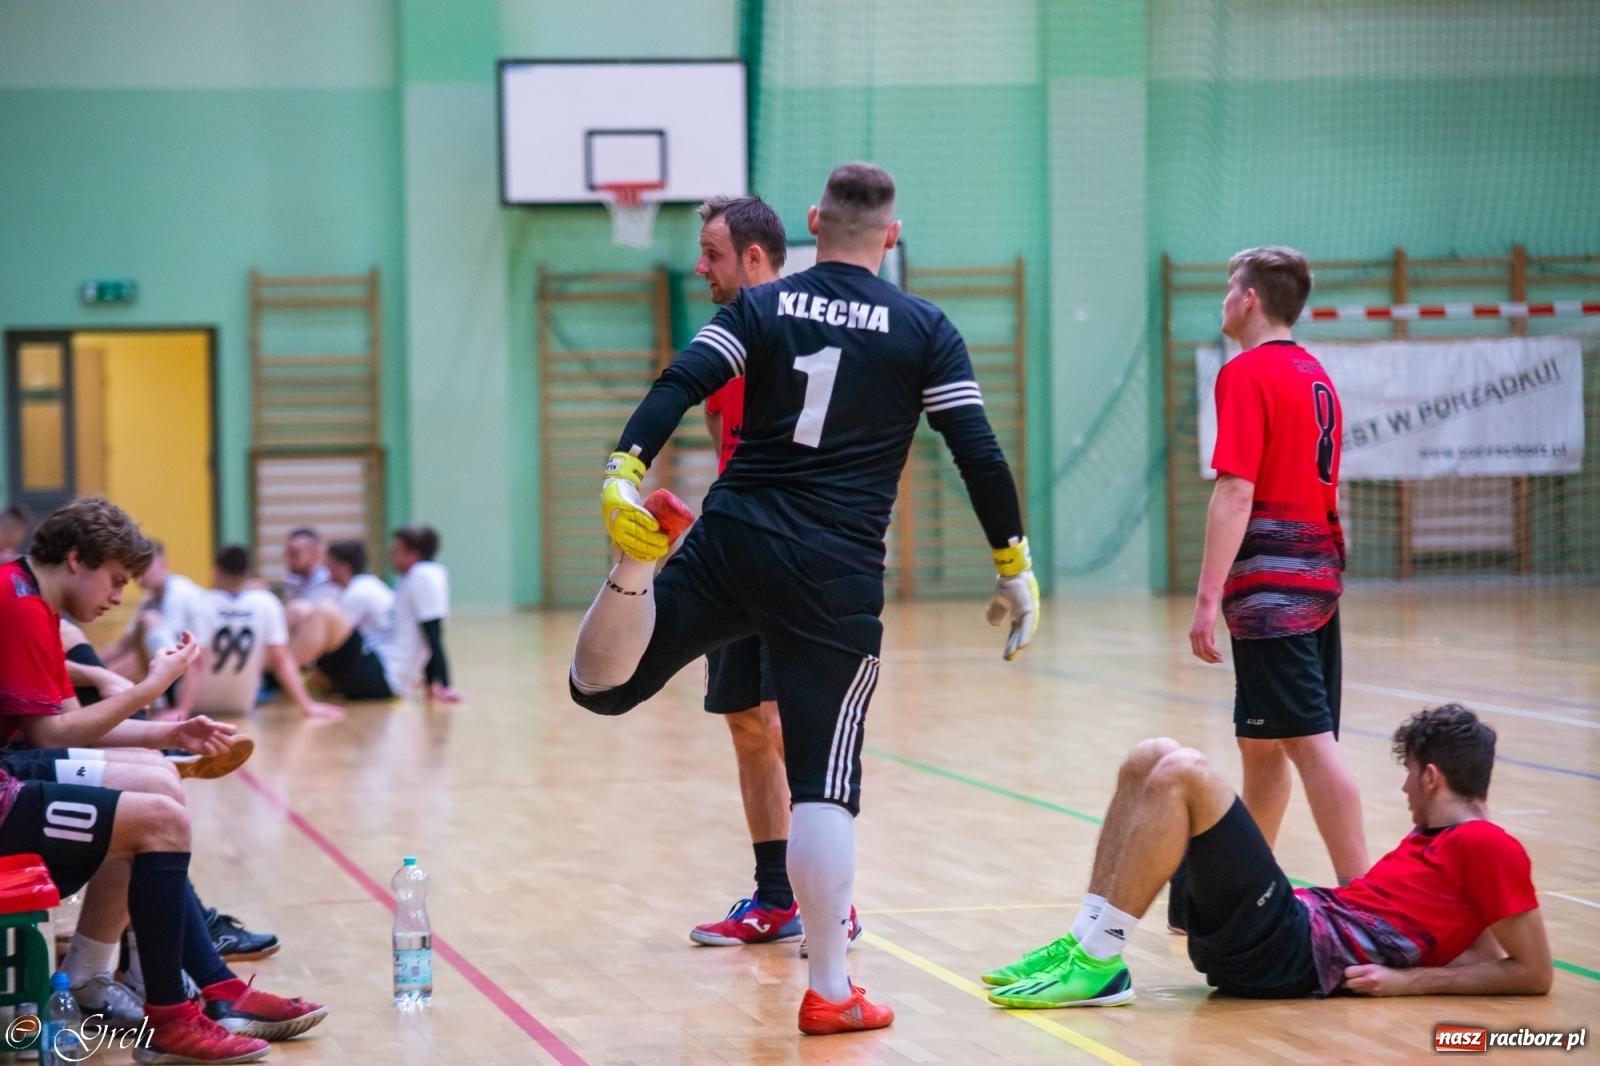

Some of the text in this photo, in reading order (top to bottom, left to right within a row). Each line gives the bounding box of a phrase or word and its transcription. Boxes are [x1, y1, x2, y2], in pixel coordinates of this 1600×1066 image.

[777, 291, 889, 333] KLECHA
[792, 345, 843, 448] 1
[1312, 381, 1336, 485] 8
[1385, 408, 1411, 434] W
[212, 625, 256, 675] 99
[43, 801, 97, 842] 10
